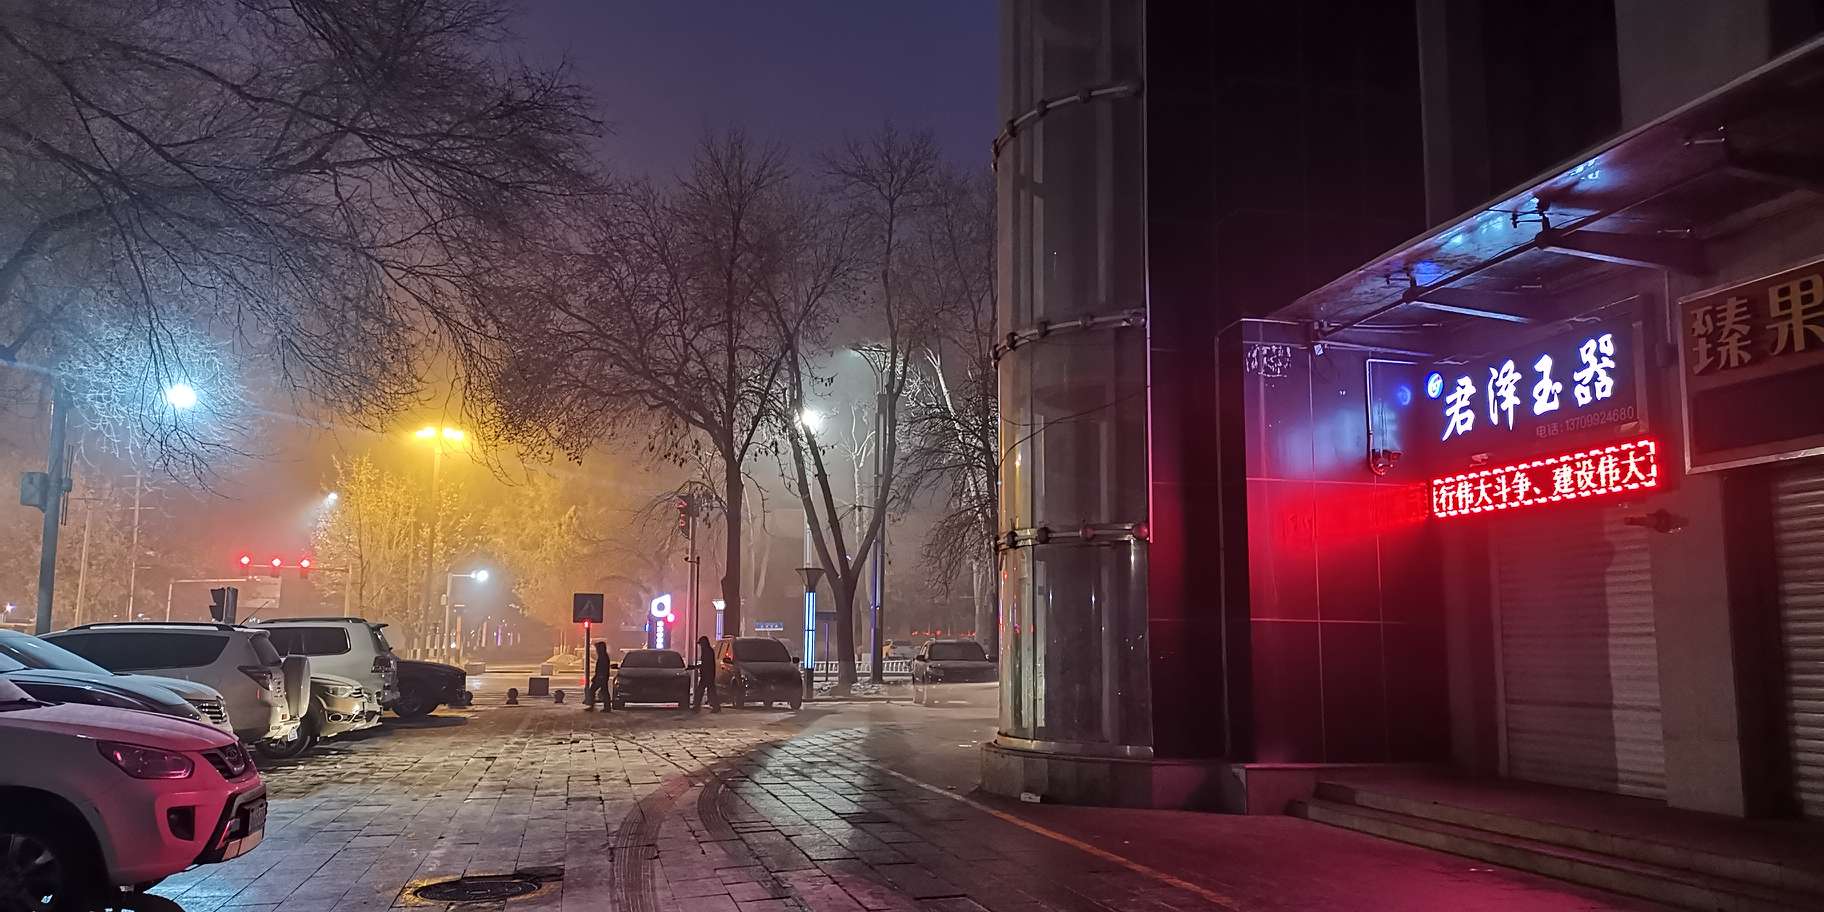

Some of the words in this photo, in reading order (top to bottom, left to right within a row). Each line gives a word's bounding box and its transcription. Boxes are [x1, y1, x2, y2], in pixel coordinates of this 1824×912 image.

[1690, 273, 1824, 375] 臻果
[1441, 333, 1616, 442] 君泽玉器
[1433, 450, 1646, 512] 行伟大斗争、建设伟大
